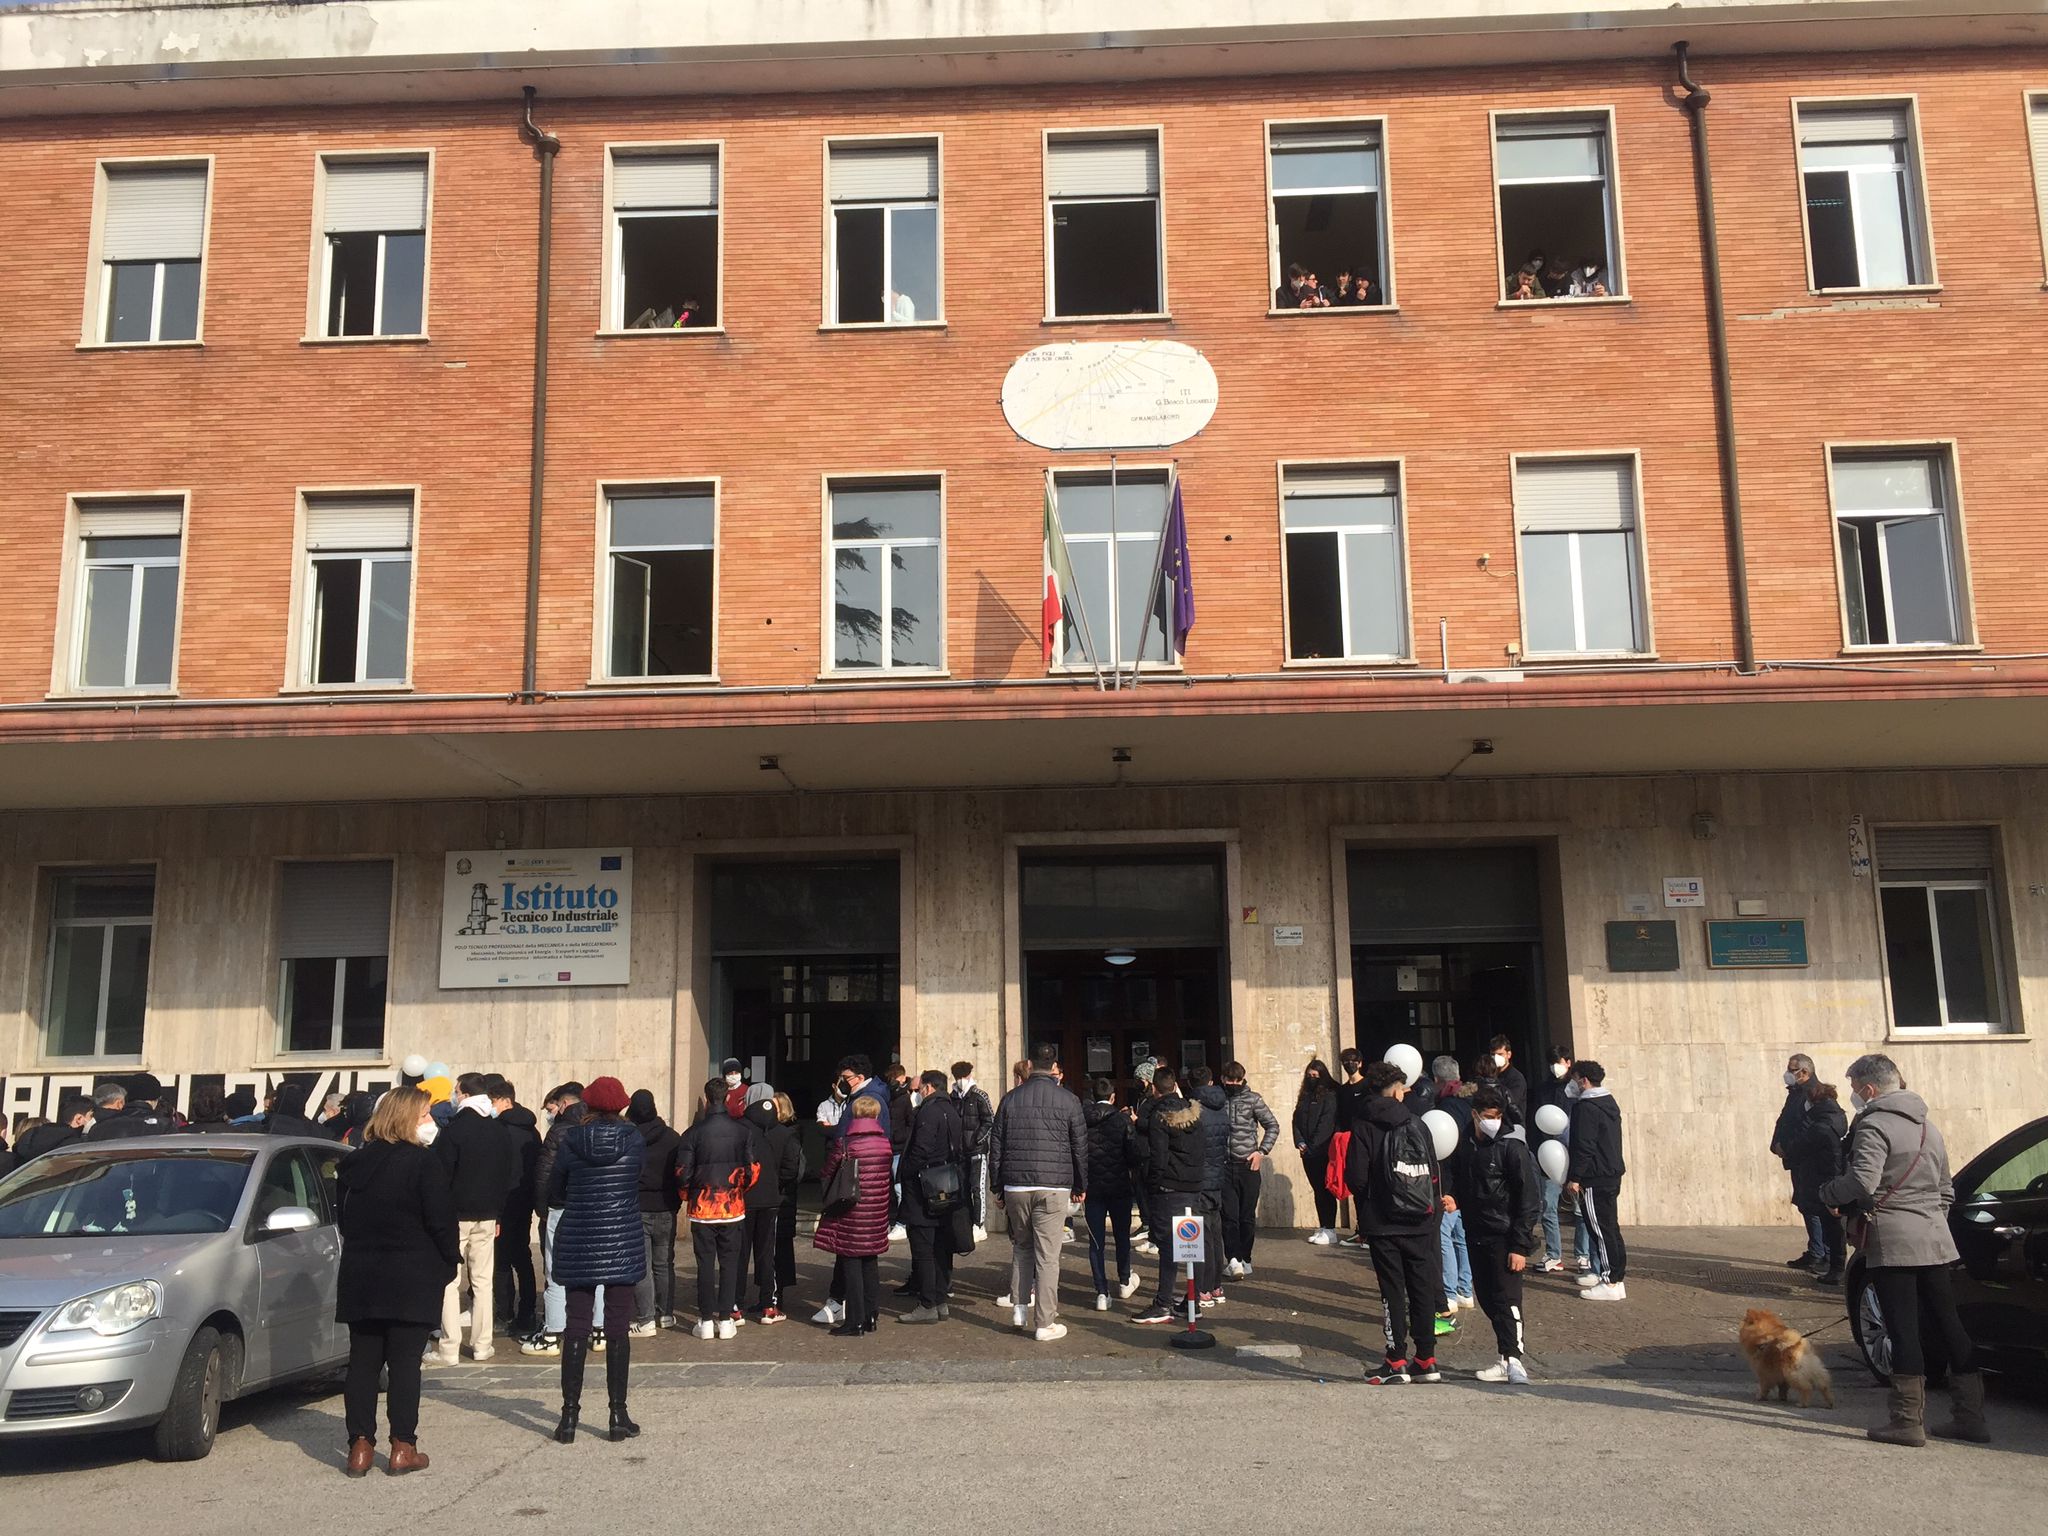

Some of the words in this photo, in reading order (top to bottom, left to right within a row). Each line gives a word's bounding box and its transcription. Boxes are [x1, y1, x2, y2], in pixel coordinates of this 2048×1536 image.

[501, 881, 618, 911] Istituto
[501, 910, 549, 923] Tecnico
[552, 909, 619, 921] Industriale
[531, 923, 563, 934] Bosco
